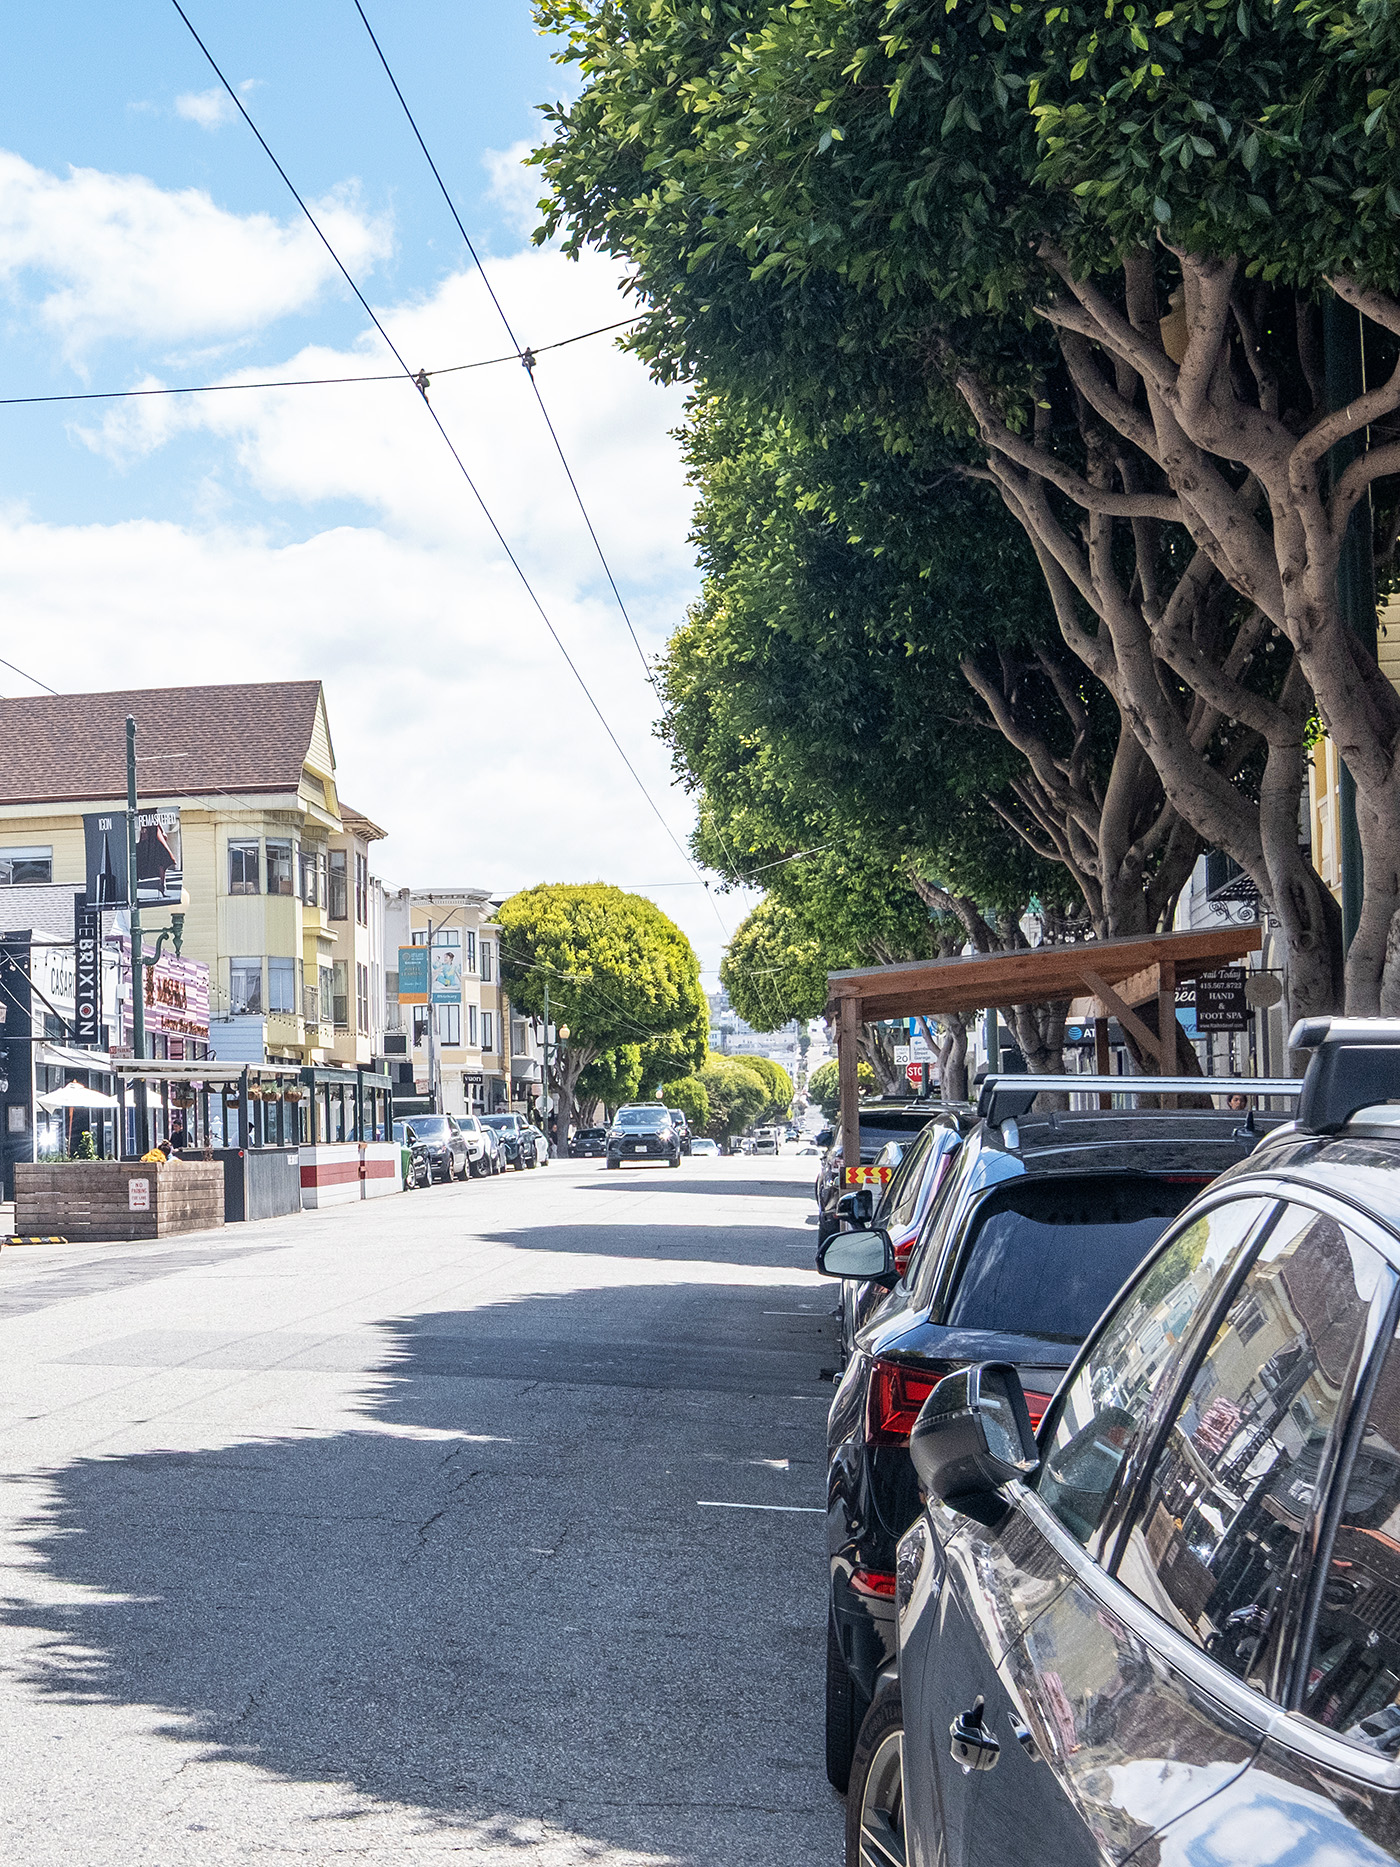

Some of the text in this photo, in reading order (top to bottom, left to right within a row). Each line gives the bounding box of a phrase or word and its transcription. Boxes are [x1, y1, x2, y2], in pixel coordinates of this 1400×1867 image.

[98, 818, 112, 831] ICON
[138, 812, 176, 828] REMASTERED
[1217, 969, 1241, 980] Today
[79, 938, 95, 1036] BRIXTON
[1209, 992, 1235, 1000] HAND
[1218, 1002, 1225, 1010] &
[1200, 1012, 1223, 1020] FOOT
[907, 1067, 922, 1076] STO
